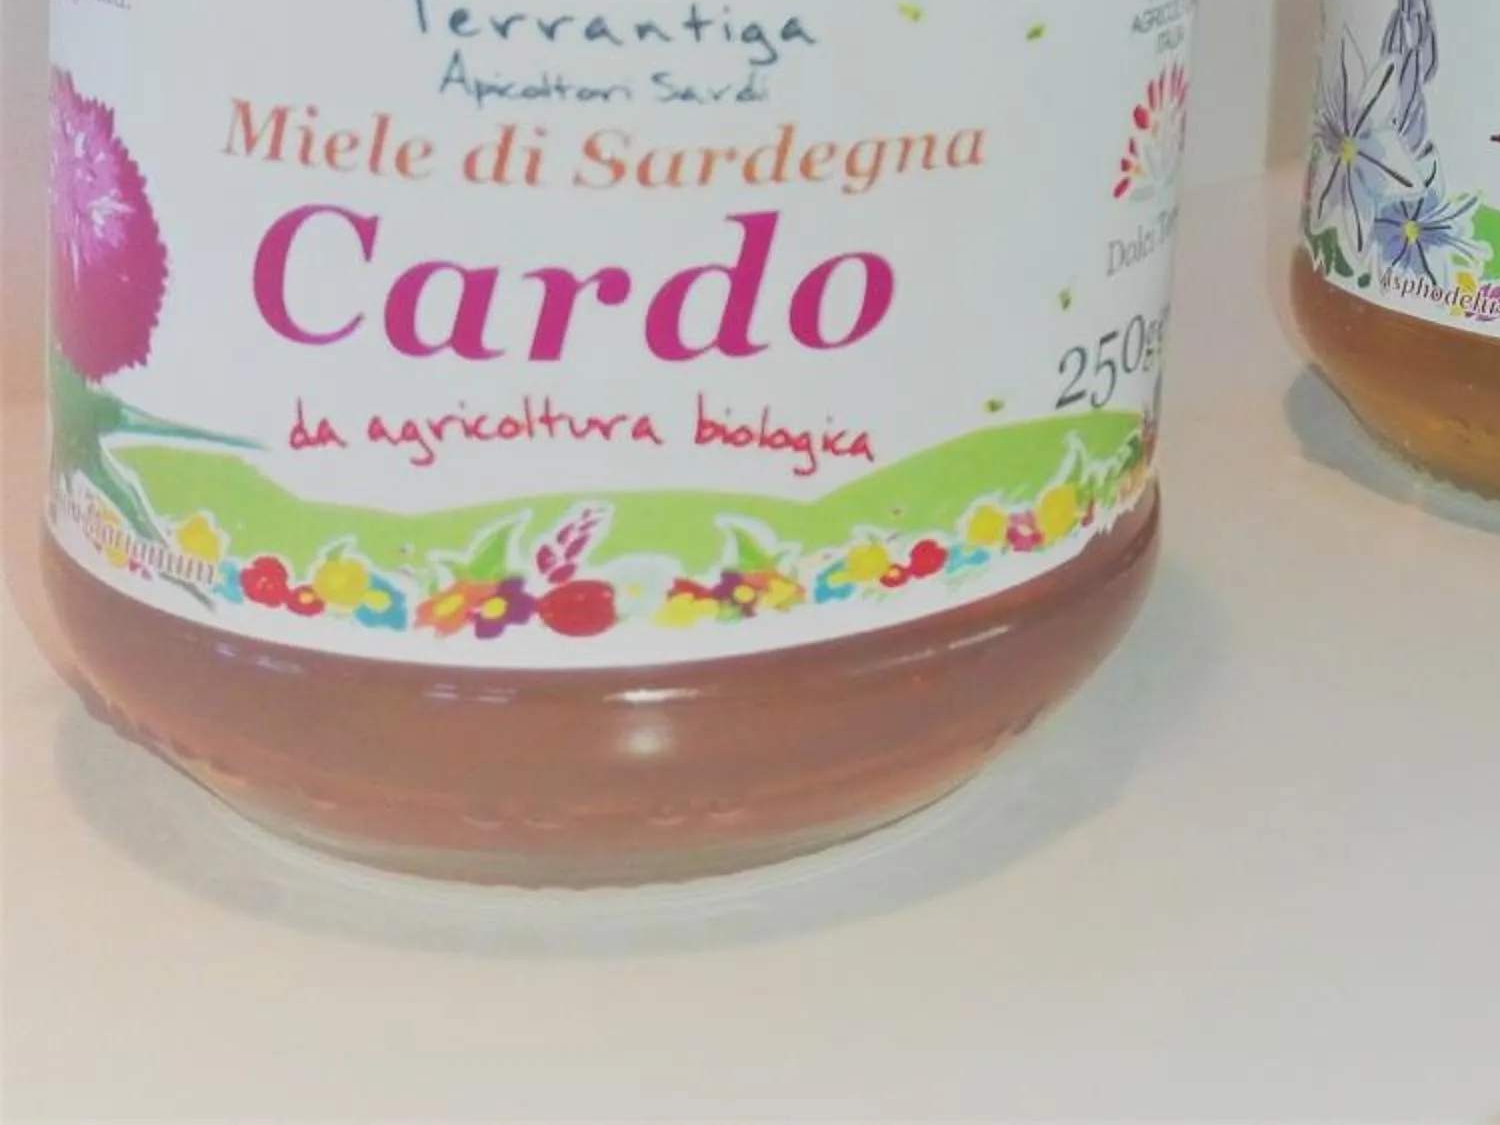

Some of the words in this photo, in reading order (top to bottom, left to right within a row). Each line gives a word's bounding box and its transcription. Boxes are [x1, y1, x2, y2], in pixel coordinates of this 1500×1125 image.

[438, 49, 632, 110] Apicoltori
[650, 71, 769, 105] Sardi
[220, 97, 436, 183] Miele
[462, 124, 548, 187] di
[572, 124, 987, 197] Sardegna
[253, 203, 895, 362] Cardo
[289, 396, 348, 451] da
[367, 394, 663, 468] agricoltura
[695, 393, 876, 476] biologica
